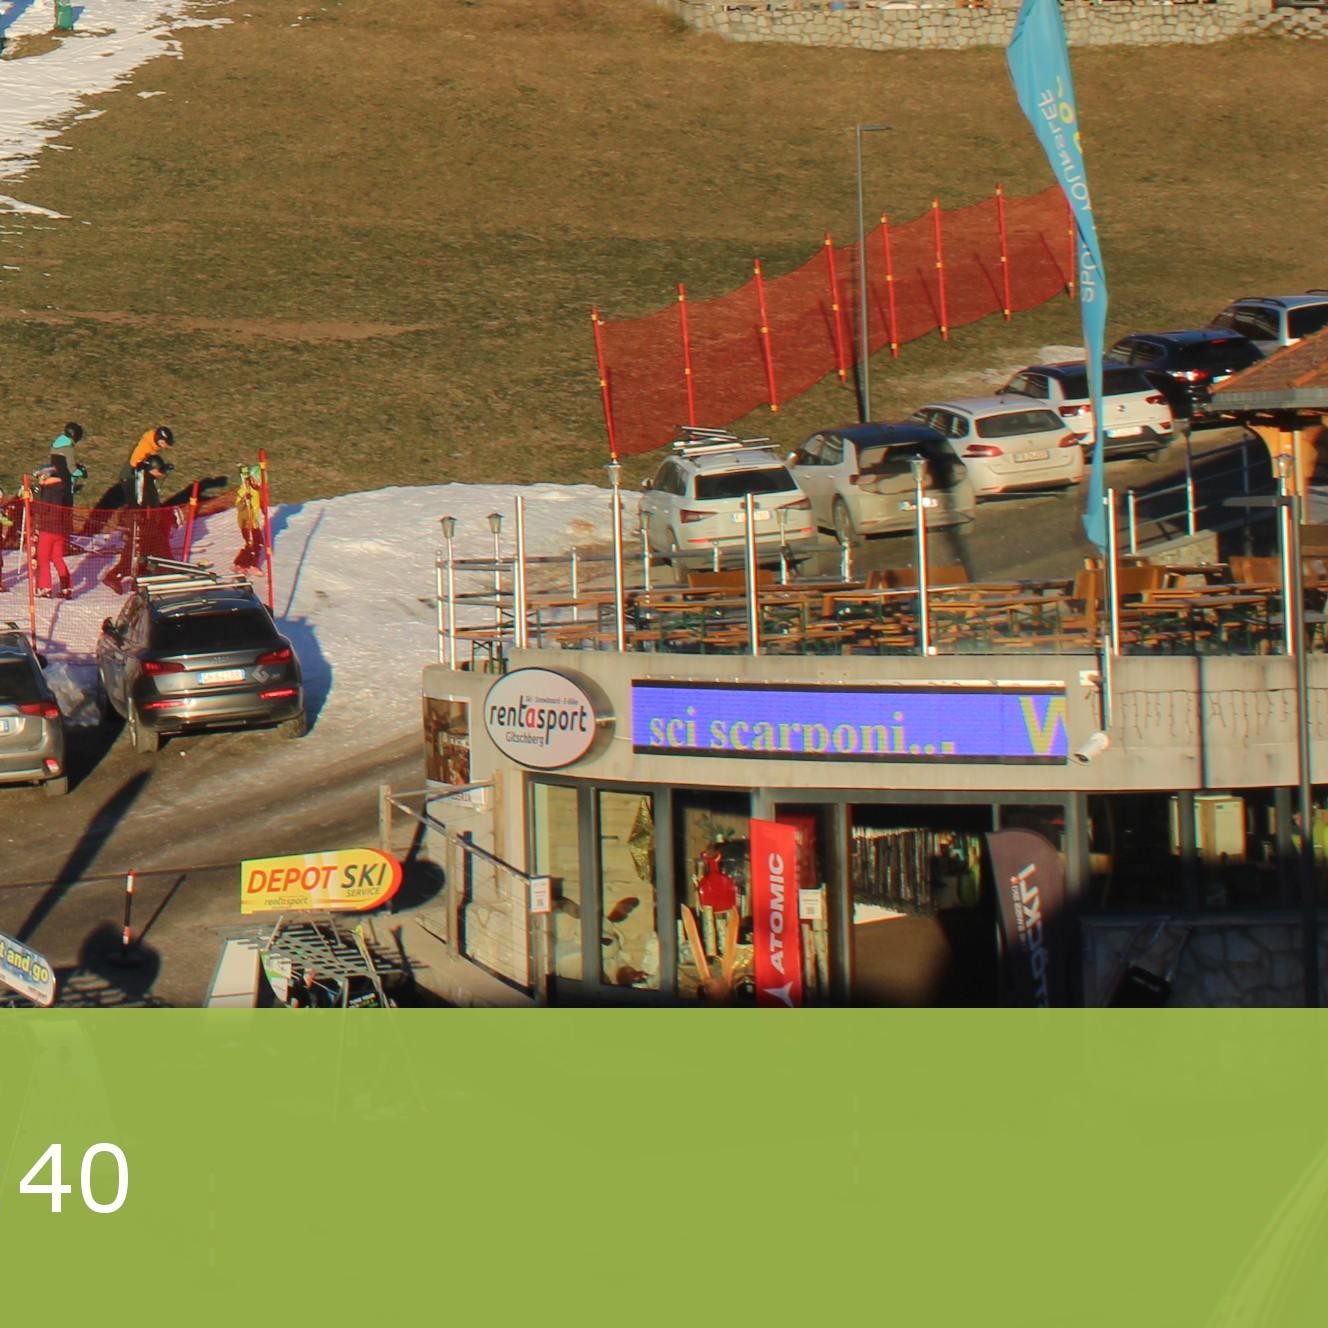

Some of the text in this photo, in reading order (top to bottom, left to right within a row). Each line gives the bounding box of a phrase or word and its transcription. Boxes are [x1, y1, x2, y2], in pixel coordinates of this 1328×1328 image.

[489, 695, 587, 745] rentasport
[648, 706, 696, 748] sci
[505, 731, 545, 747] Gitschberg
[247, 863, 387, 894] DEPOT SKI
[345, 887, 381, 897] SERVICE
[769, 853, 785, 975] ATOMIC
[6, 948, 31, 972] and
[31, 963, 49, 982] go
